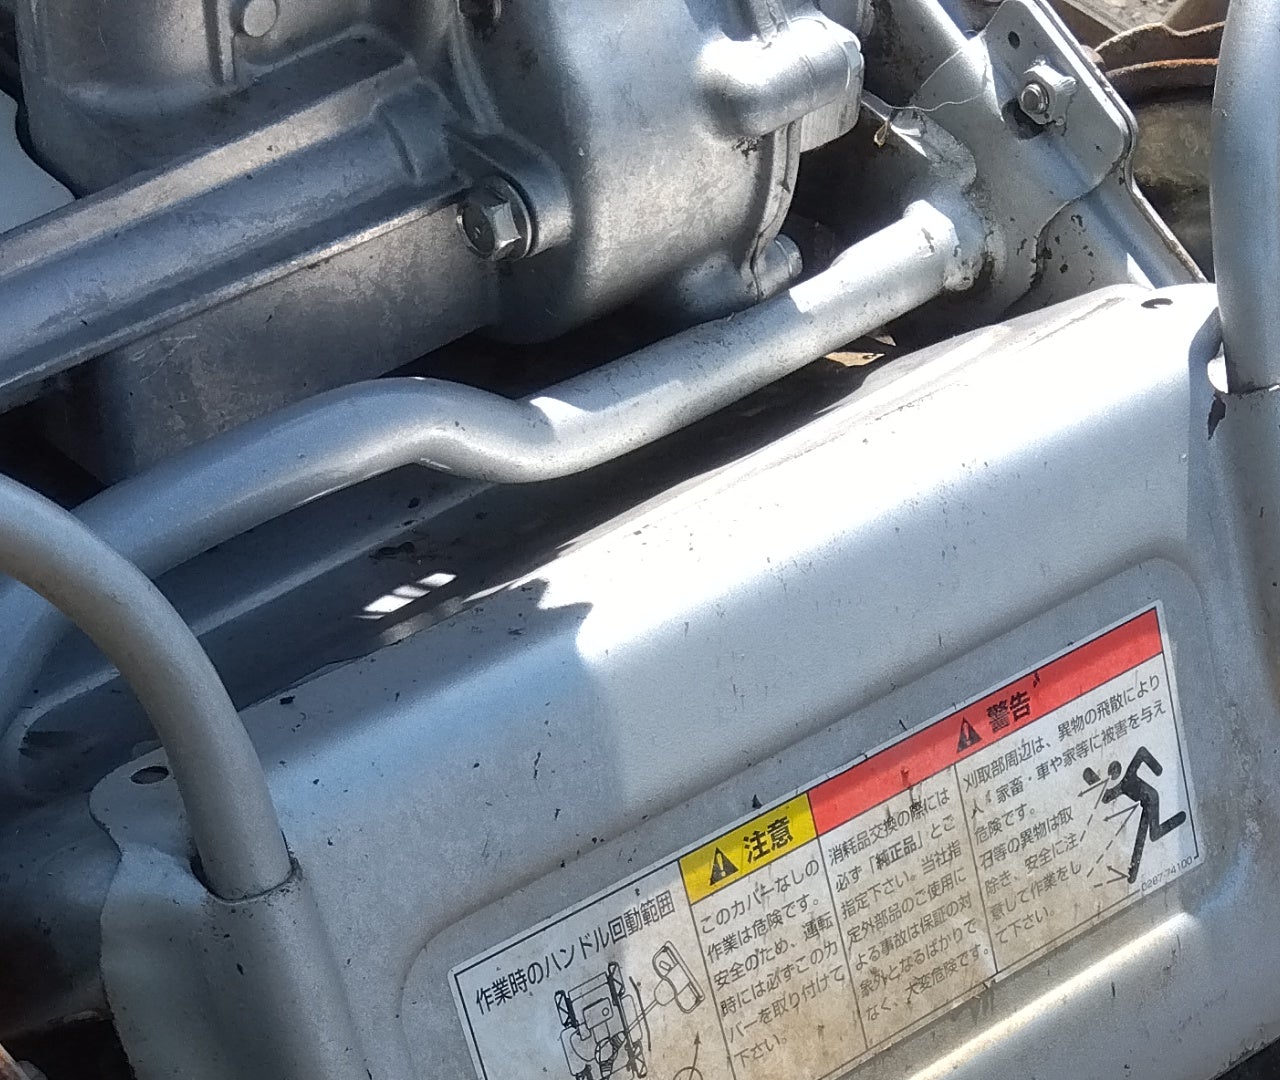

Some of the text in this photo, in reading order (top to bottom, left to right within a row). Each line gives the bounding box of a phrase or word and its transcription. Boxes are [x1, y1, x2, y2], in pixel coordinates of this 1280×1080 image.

[962, 671, 1160, 793] 刈取部周辺は、異物の飛散により
[985, 687, 1032, 735] 警告
[742, 814, 793, 864] 注意
[827, 785, 950, 866] 消耗品交換の際には
[834, 812, 956, 893] 必ず「純正品」とご
[973, 797, 1036, 846] 危険です。
[979, 805, 1074, 872] 石等の異物は取
[699, 856, 820, 936] このカバーなしの
[840, 838, 961, 920] 指定下さい。当社指
[984, 830, 1078, 897] 除き、安全に注
[989, 856, 1082, 922] 意して作業をし
[1141, 855, 1193, 892] 0287-74100
[706, 887, 819, 964] 作業は危険です。
[846, 865, 966, 946] 定外部品のご使用に
[852, 891, 972, 972] よる事故は保証の対
[995, 899, 1055, 947] て下さい。
[473, 888, 676, 1017] 作業時のハンドル回動範囲
[713, 909, 833, 991] 安全のため、運転
[720, 937, 839, 1017] 時には必ずこのカ
[858, 917, 978, 998] 象外となるばかりで
[864, 938, 989, 1024] なく、大変危険です。
[727, 963, 845, 1044] バーを取り付けて
[733, 1026, 788, 1071] 下さい。
